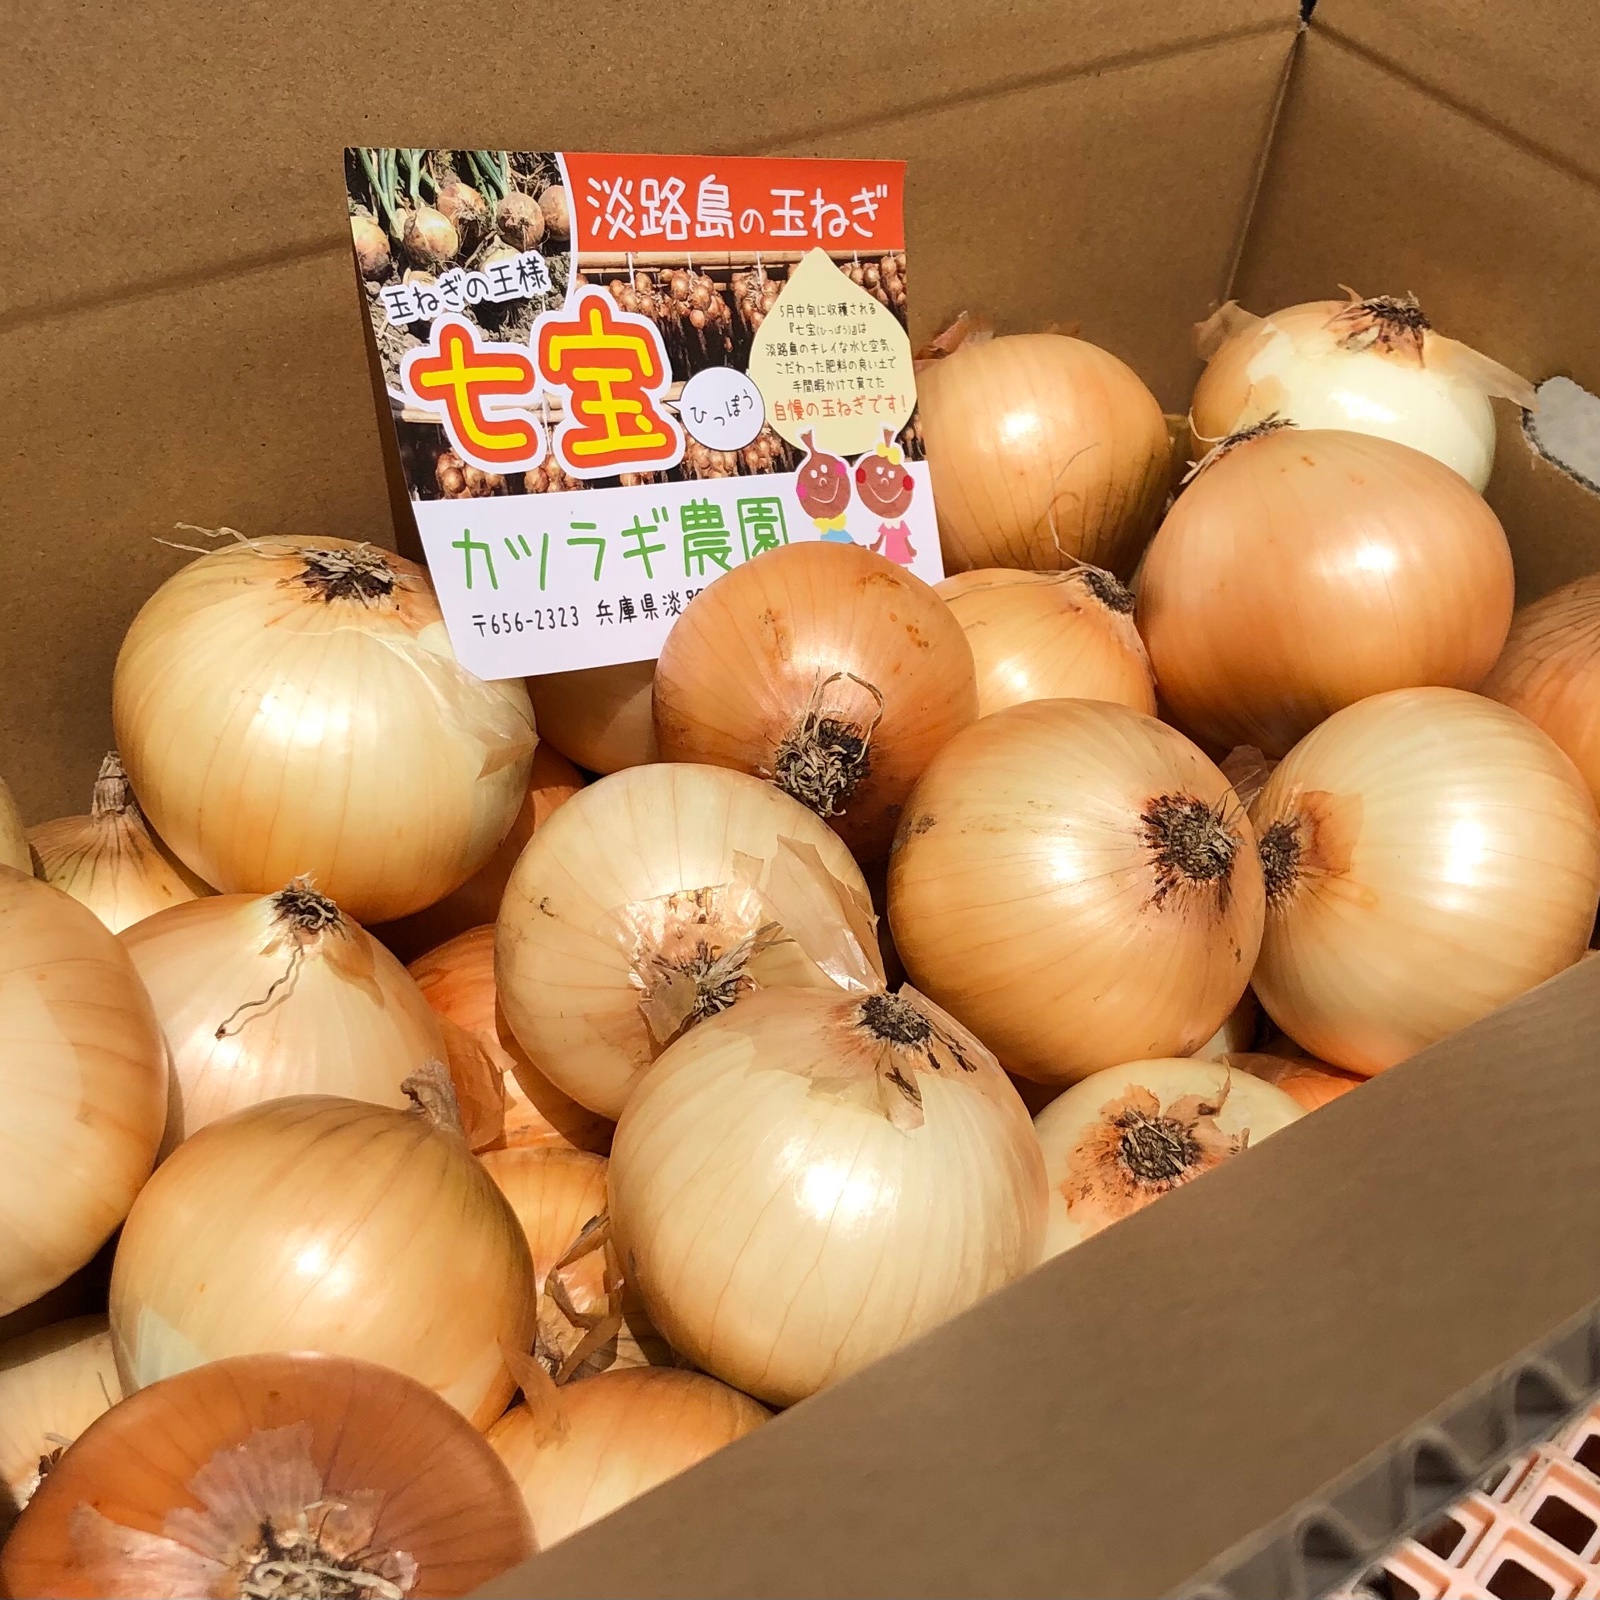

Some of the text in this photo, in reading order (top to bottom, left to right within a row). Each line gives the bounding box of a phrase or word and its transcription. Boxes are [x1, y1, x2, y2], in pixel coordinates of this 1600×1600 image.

[586, 174, 889, 241] 淡路島の玉ねぎ
[385, 258, 549, 319] 玉ねぎの王様
[411, 294, 679, 466] 七宝
[776, 357, 896, 374] こだわった肥料の良い土で
[793, 377, 884, 393] 手間暇かけて育てた
[692, 389, 755, 426] ひっぽう
[774, 395, 906, 420] 自慢の玉ねぎです!
[451, 496, 790, 590] カツラギ農園
[472, 605, 580, 637] 〒656-2323
